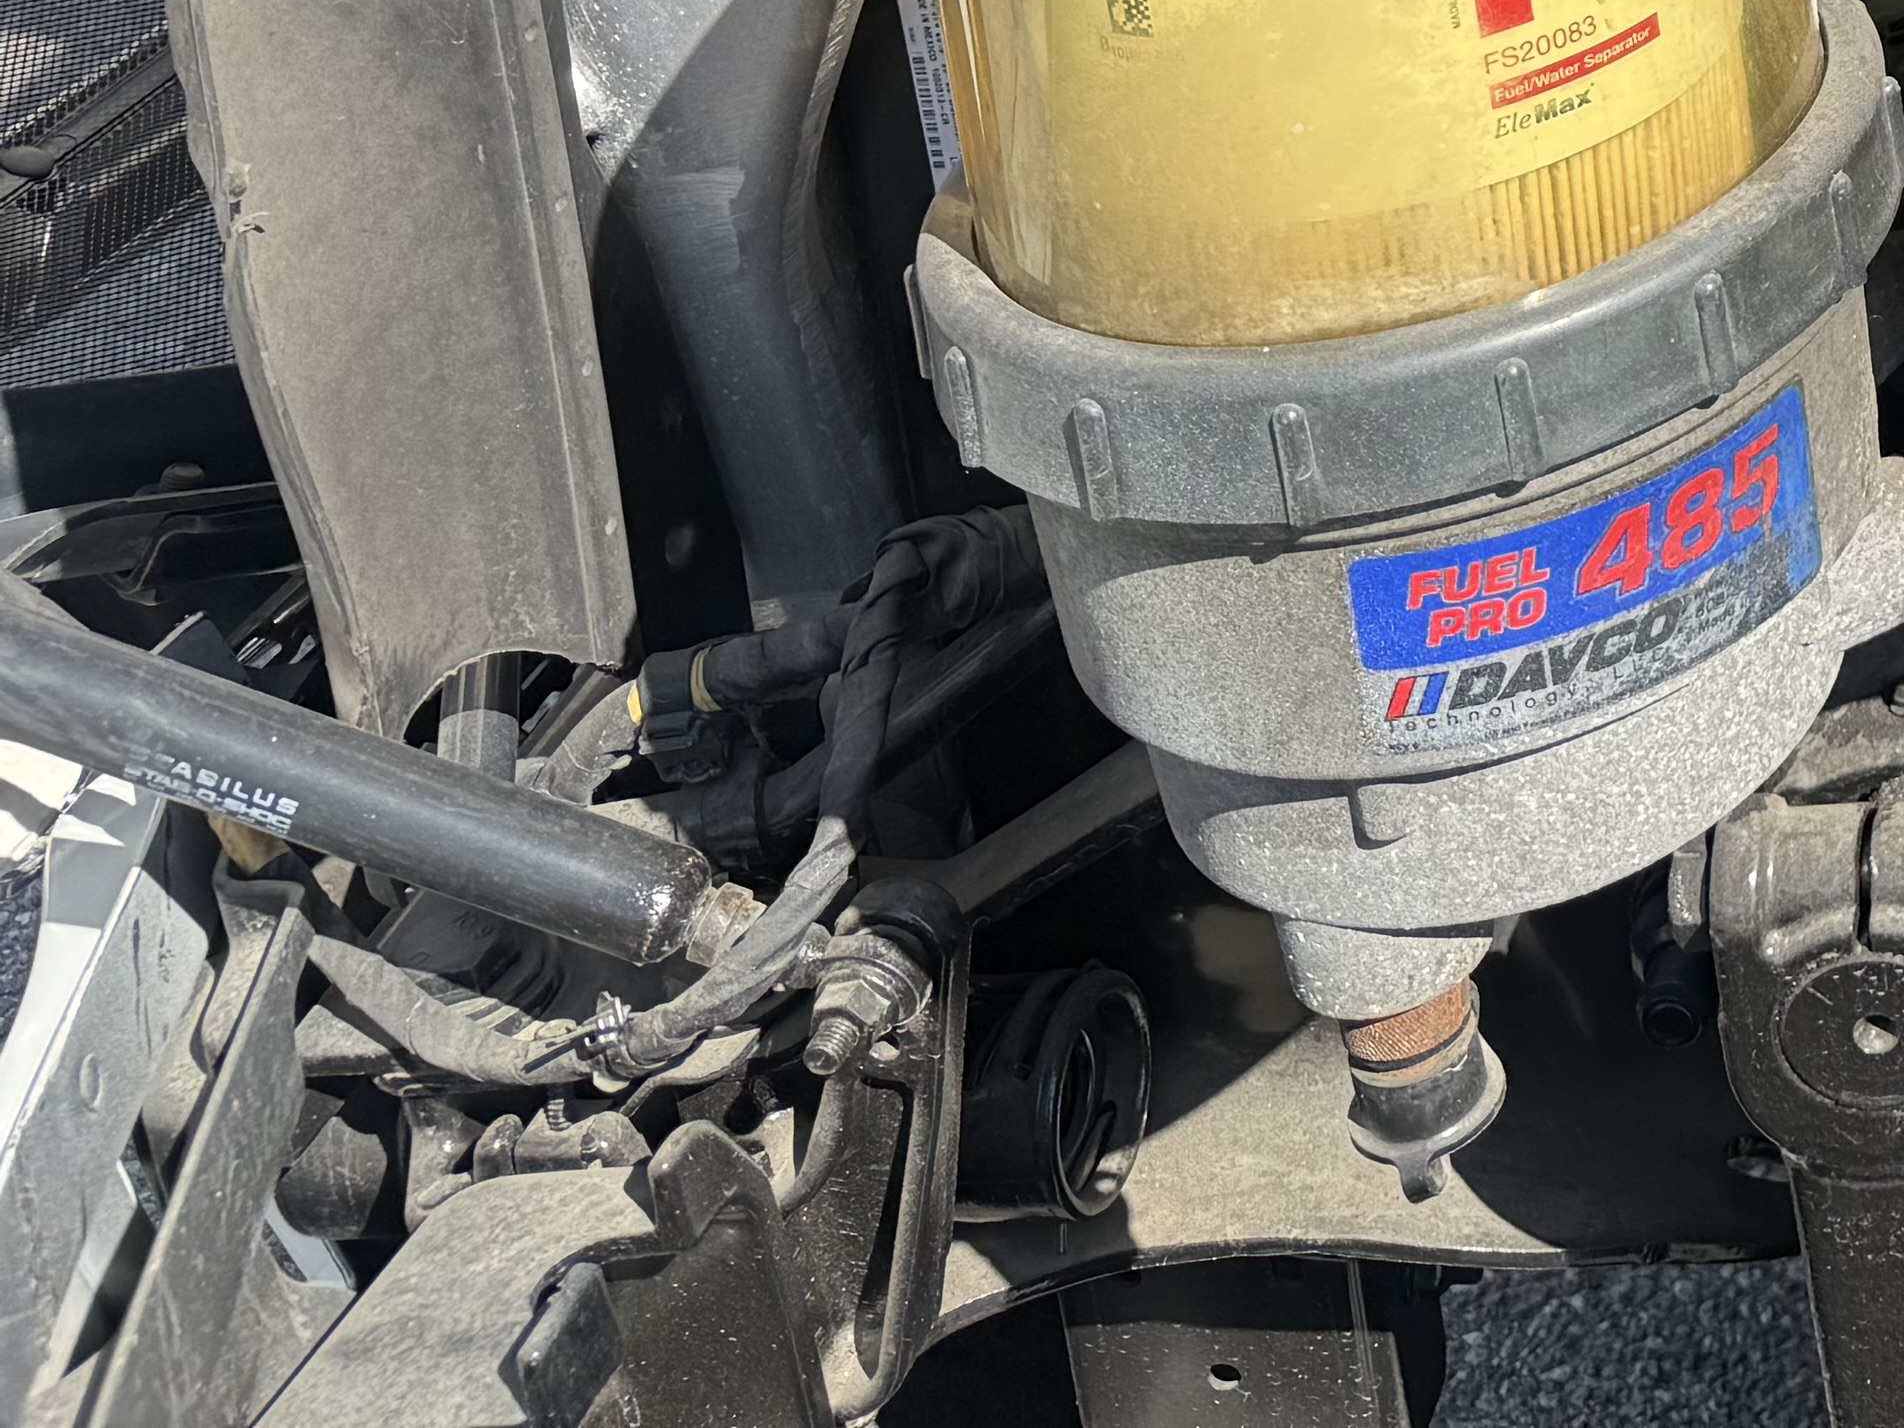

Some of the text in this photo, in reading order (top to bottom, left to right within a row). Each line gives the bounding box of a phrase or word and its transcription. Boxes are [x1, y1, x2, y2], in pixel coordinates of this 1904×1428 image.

[919, 14, 928, 23] IN
[924, 27, 937, 61] MEXICO
[1450, 5, 1461, 30] MADE
[1484, 14, 1599, 76] FS20083
[1493, 24, 1654, 106] Fuel/Water Separator
[1494, 86, 1592, 140] EleMax
[1407, 422, 1781, 610] FUEL 485
[1426, 587, 1548, 649] PRO
[1448, 599, 1679, 711] DAVCO
